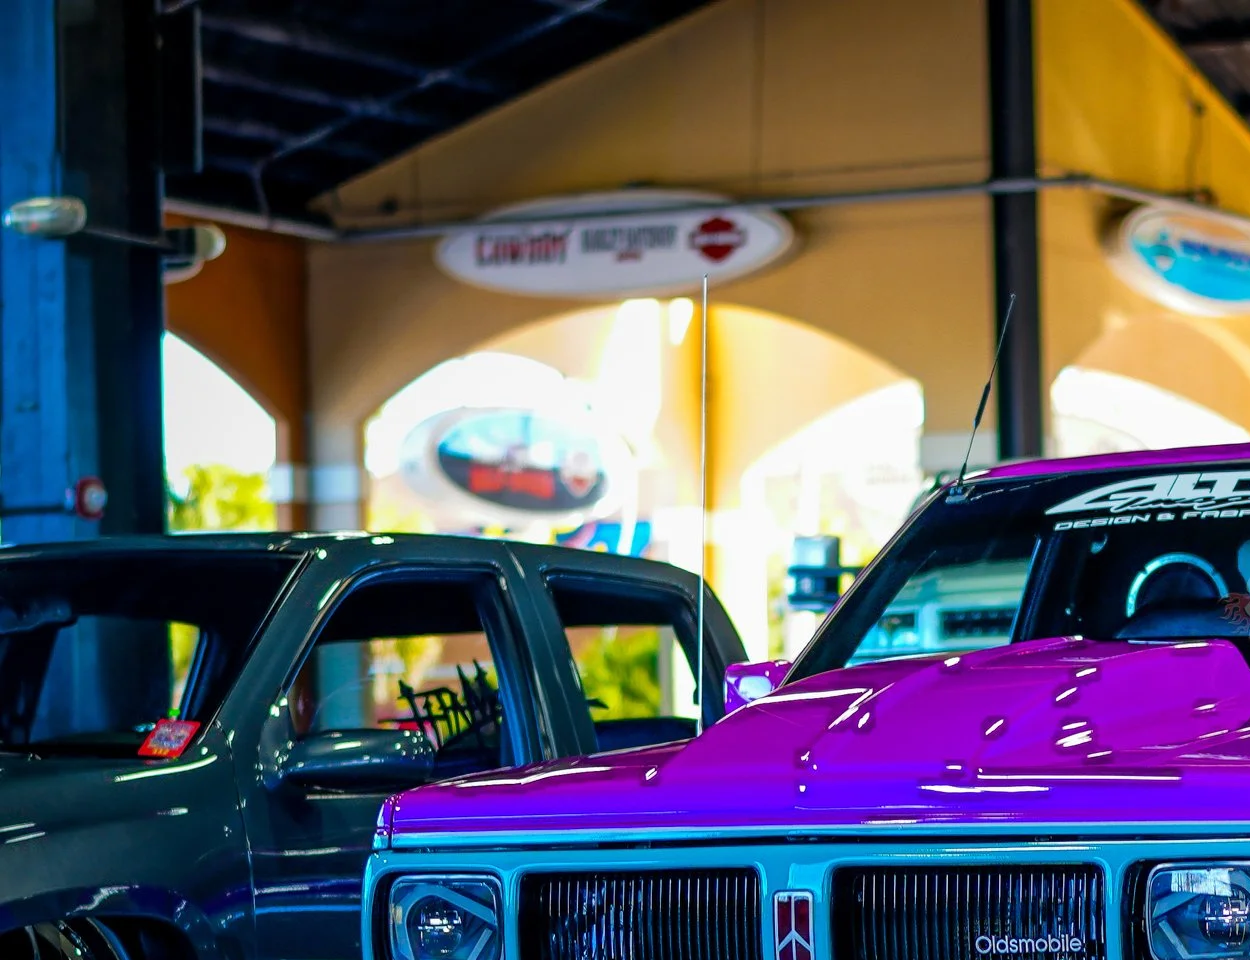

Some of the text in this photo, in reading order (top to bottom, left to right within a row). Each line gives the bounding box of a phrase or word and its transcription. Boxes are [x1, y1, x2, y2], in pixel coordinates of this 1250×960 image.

[1054, 513, 1152, 531] DESIGN
[1156, 512, 1176, 522] &
[975, 934, 1082, 954] Oldsmobile
